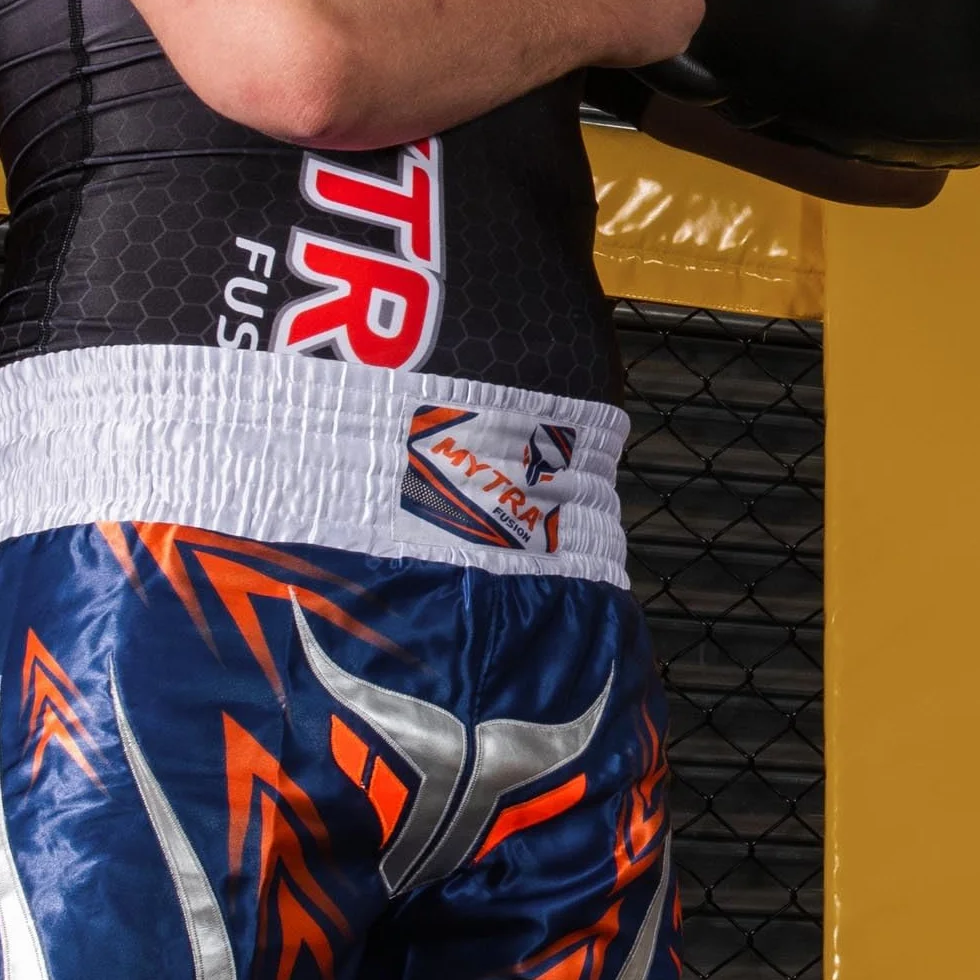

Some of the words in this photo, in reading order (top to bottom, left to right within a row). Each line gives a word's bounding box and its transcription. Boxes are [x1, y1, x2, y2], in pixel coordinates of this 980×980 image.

[270, 135, 446, 372] TR
[431, 437, 541, 532] MYTRA
[492, 507, 532, 543] FUSION
